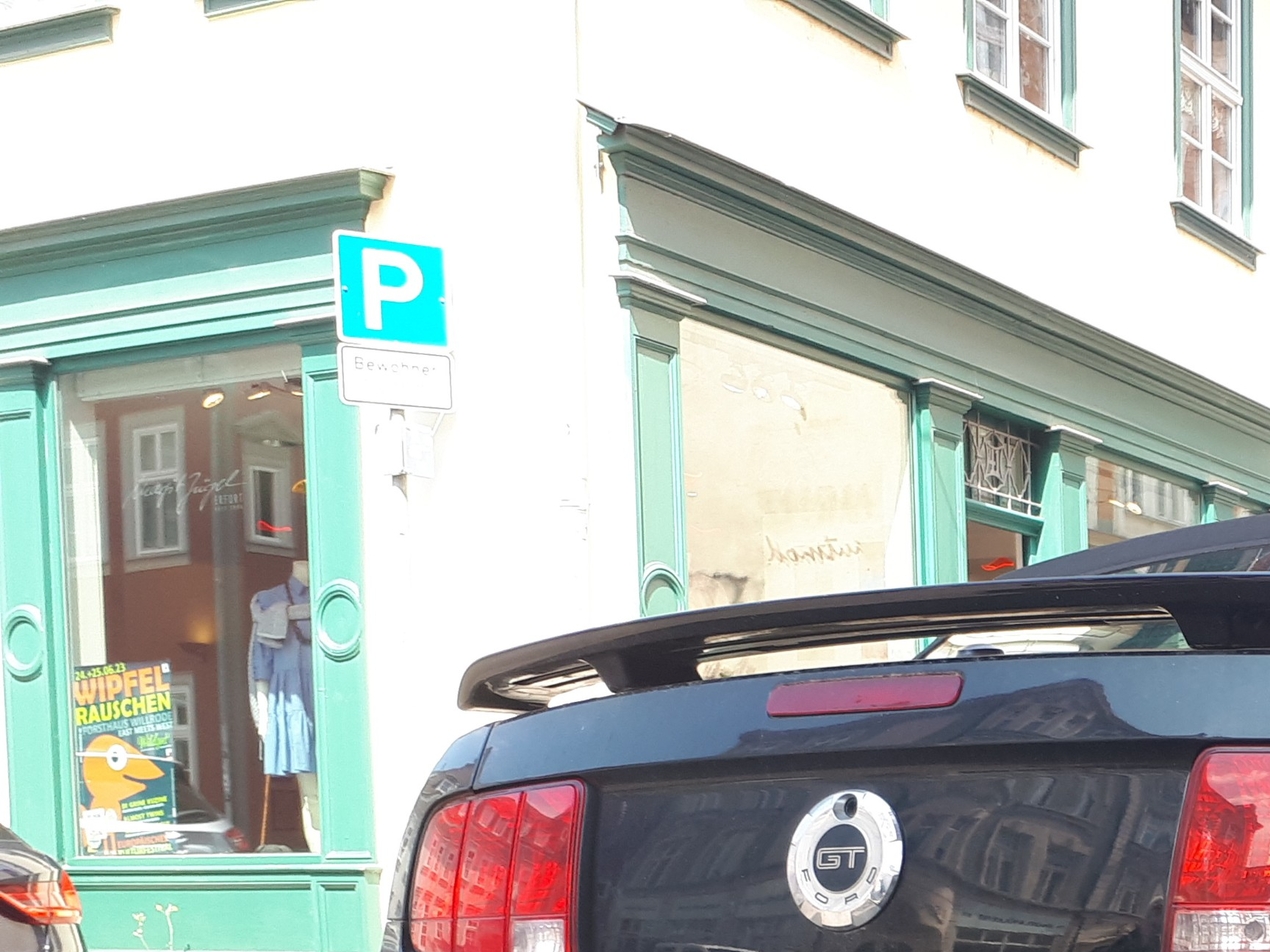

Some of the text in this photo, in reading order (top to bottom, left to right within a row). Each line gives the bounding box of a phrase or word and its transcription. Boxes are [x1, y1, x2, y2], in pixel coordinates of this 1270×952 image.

[362, 247, 424, 331] P
[354, 356, 436, 376] Bewohne
[74, 665, 171, 706] WIPFEL
[75, 691, 172, 727] RAUSCHEN
[117, 728, 133, 737] EAST
[816, 846, 865, 870] GT
